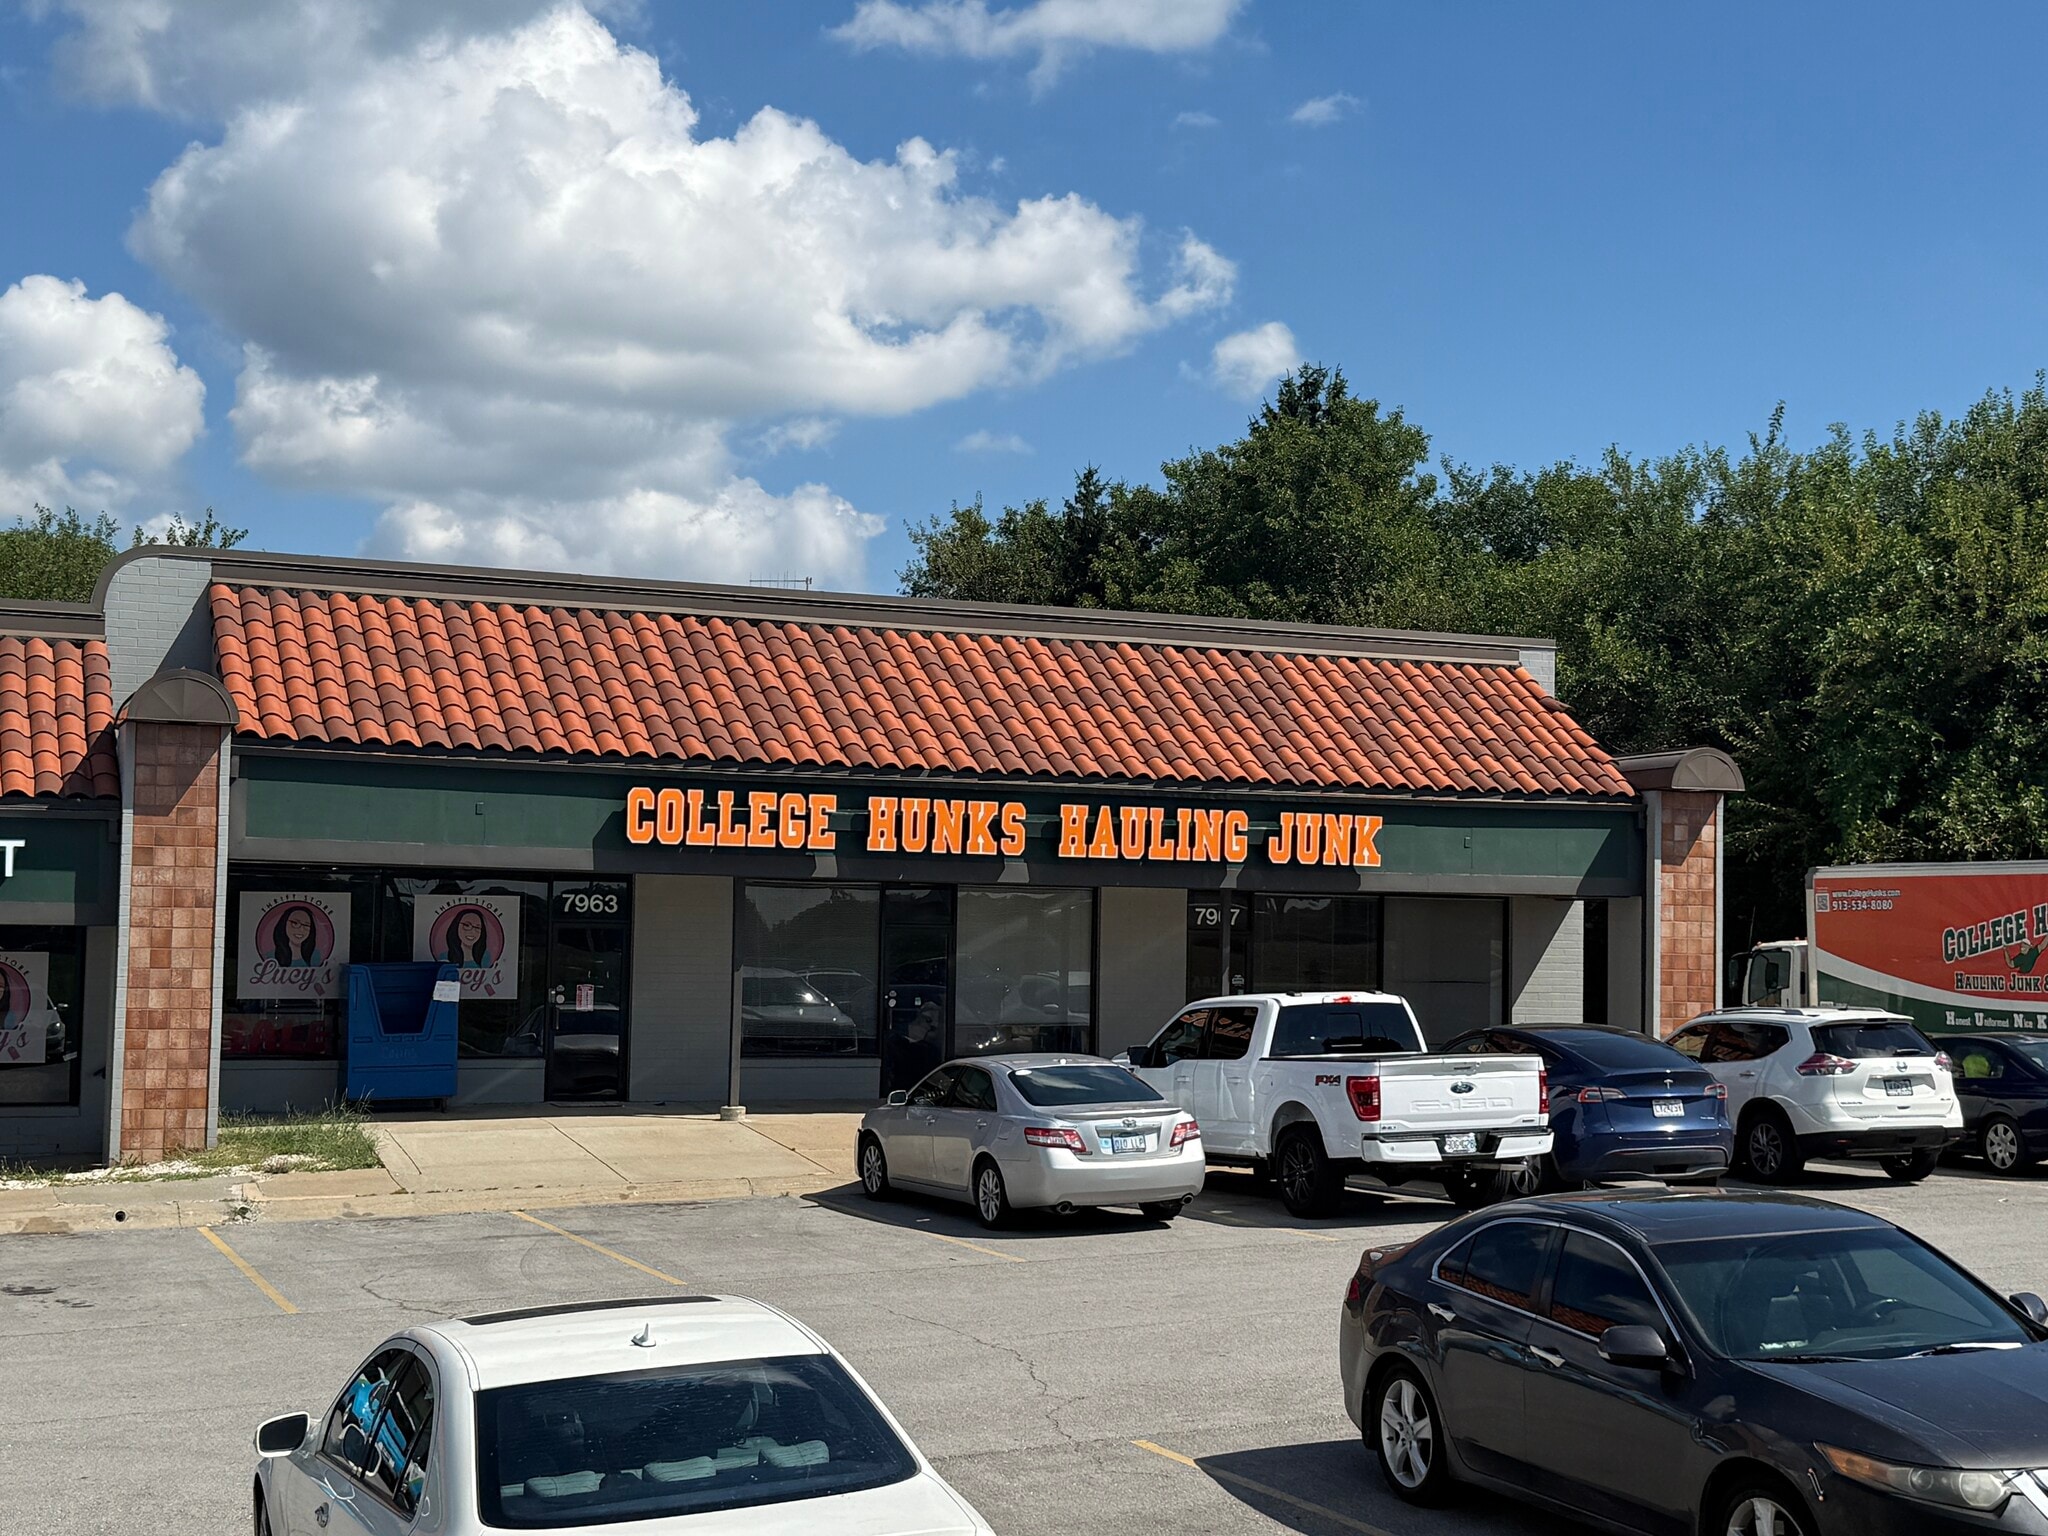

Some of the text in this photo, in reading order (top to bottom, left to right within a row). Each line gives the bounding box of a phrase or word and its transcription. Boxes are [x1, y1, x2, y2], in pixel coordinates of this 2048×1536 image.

[626, 786, 1383, 867] COLLEGE HUNKS HAULING JUNK
[0, 839, 26, 878] T
[261, 894, 334, 915] THRIFT STORE
[475, 898, 503, 918] STORE
[562, 894, 618, 913] 7963
[1832, 899, 1893, 911] 913-534-8080
[1195, 908, 1240, 926] 797
[1942, 908, 2027, 964] COLLEGE
[0, 954, 30, 976] TORE
[250, 959, 335, 991] Lucy's
[1954, 971, 2005, 992] HAULING
[2008, 972, 2042, 993] JUNK
[1409, 1097, 1514, 1113] F-150
